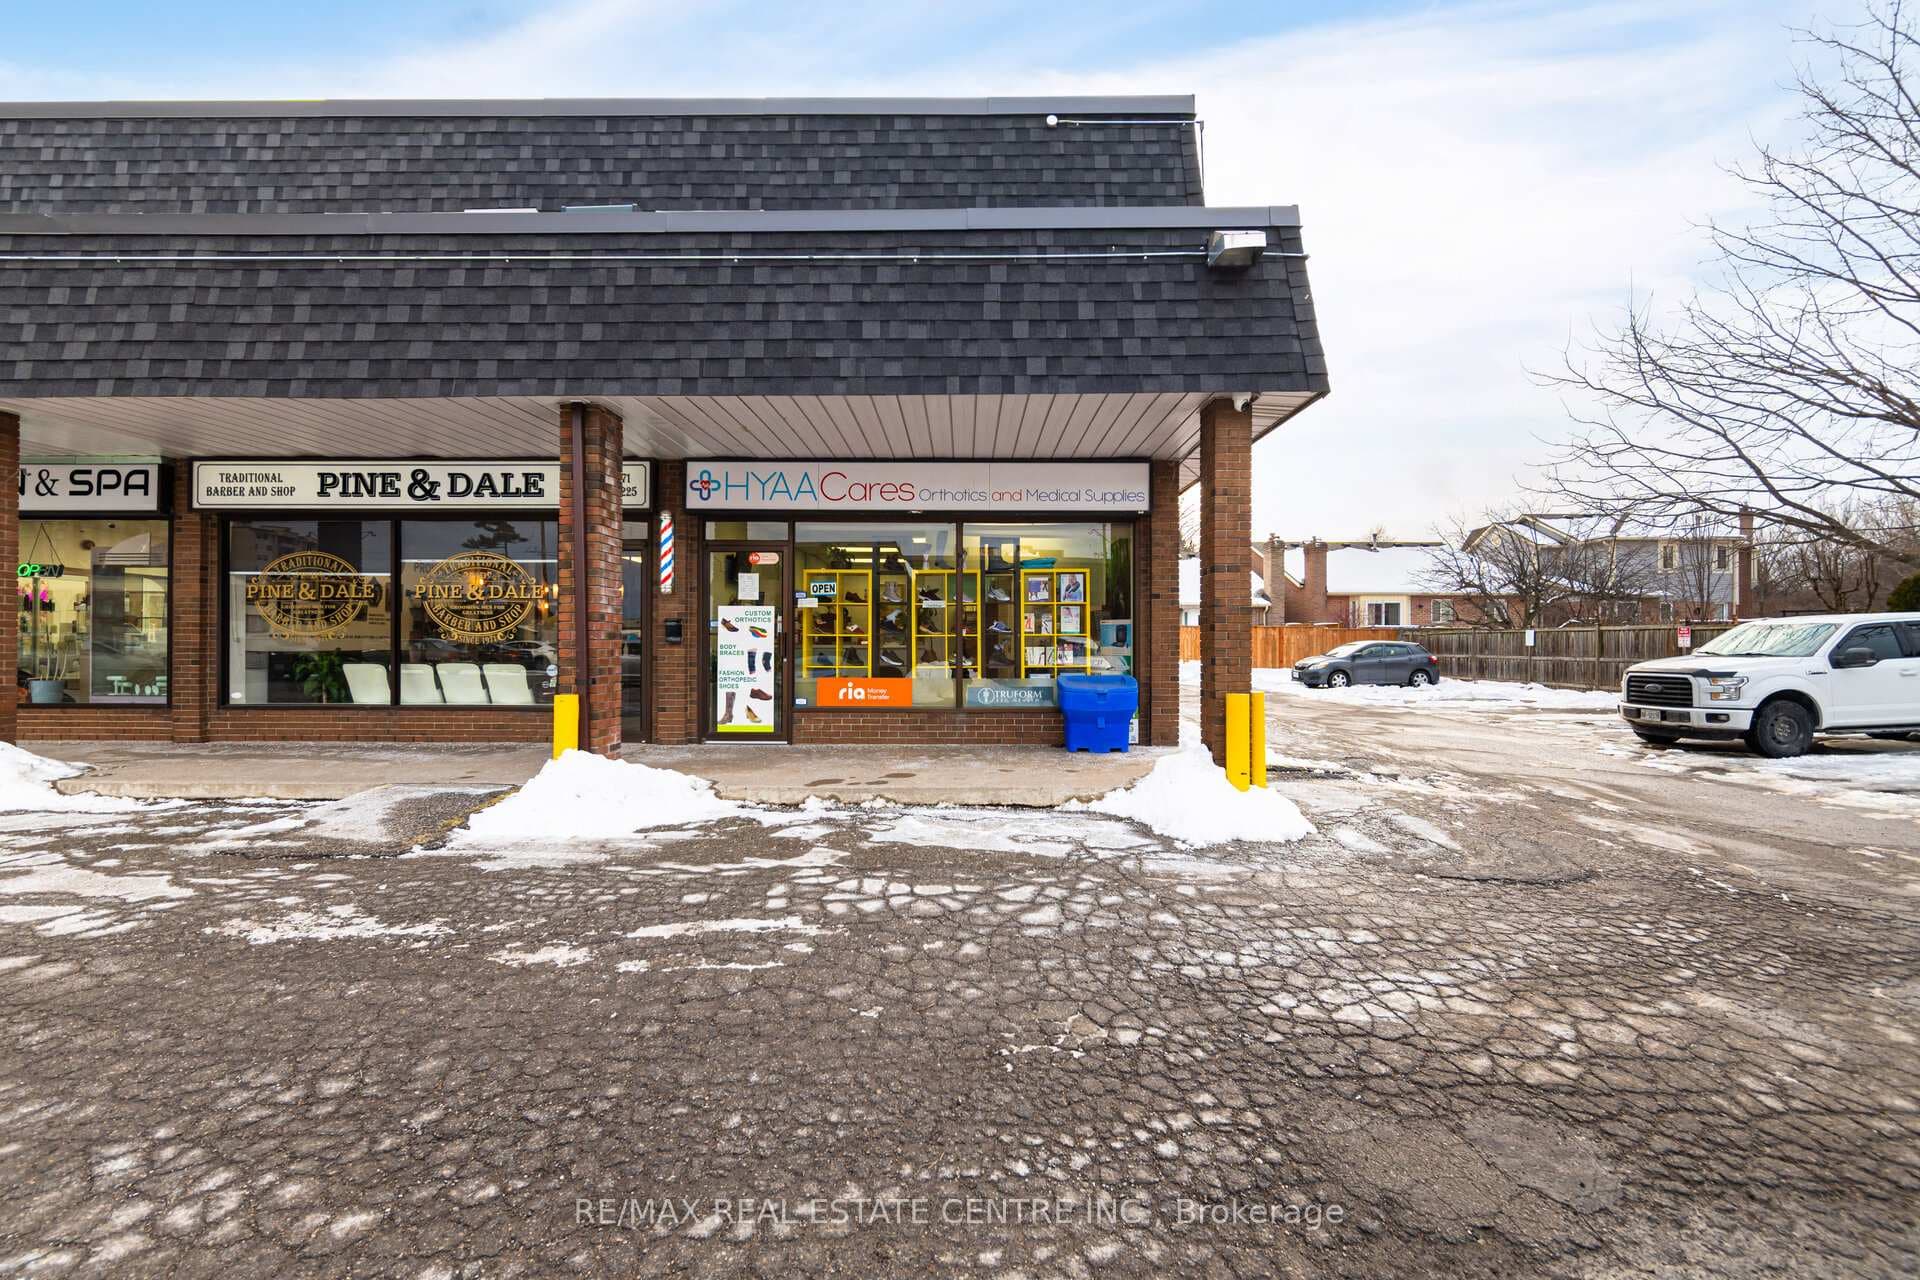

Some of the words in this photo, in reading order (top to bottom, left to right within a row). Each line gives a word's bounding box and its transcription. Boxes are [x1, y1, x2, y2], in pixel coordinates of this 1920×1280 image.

[35, 469, 59, 496] &
[69, 469, 149, 496] SPA
[219, 472, 284, 483] TRADITIONAL
[316, 472, 401, 498] PINE
[407, 468, 441, 501] &
[447, 472, 545, 498] DALE
[206, 486, 245, 497] BARBER
[248, 486, 268, 497] AND
[271, 486, 296, 497] SHOP
[918, 488, 988, 502] Orthotics
[991, 488, 1023, 502] and
[1025, 488, 1081, 502] Medical
[1084, 488, 1146, 505] Supplies
[274, 556, 346, 574] TRADITIONAL
[443, 556, 515, 574] TRADITIONAL
[246, 584, 294, 599] PINE
[298, 582, 317, 600] &
[320, 584, 375, 599] DALE
[415, 584, 463, 599] PINE
[467, 582, 485, 600] &
[487, 584, 544, 599] DALE
[812, 584, 836, 593] OPEN
[330, 603, 354, 627] SHOP
[432, 603, 471, 632] BARBER
[474, 619, 497, 632] AND
[498, 603, 523, 627] SHOP
[838, 681, 865, 700] ria
[867, 687, 888, 695] Money
[994, 690, 1042, 699] TRUFORM
